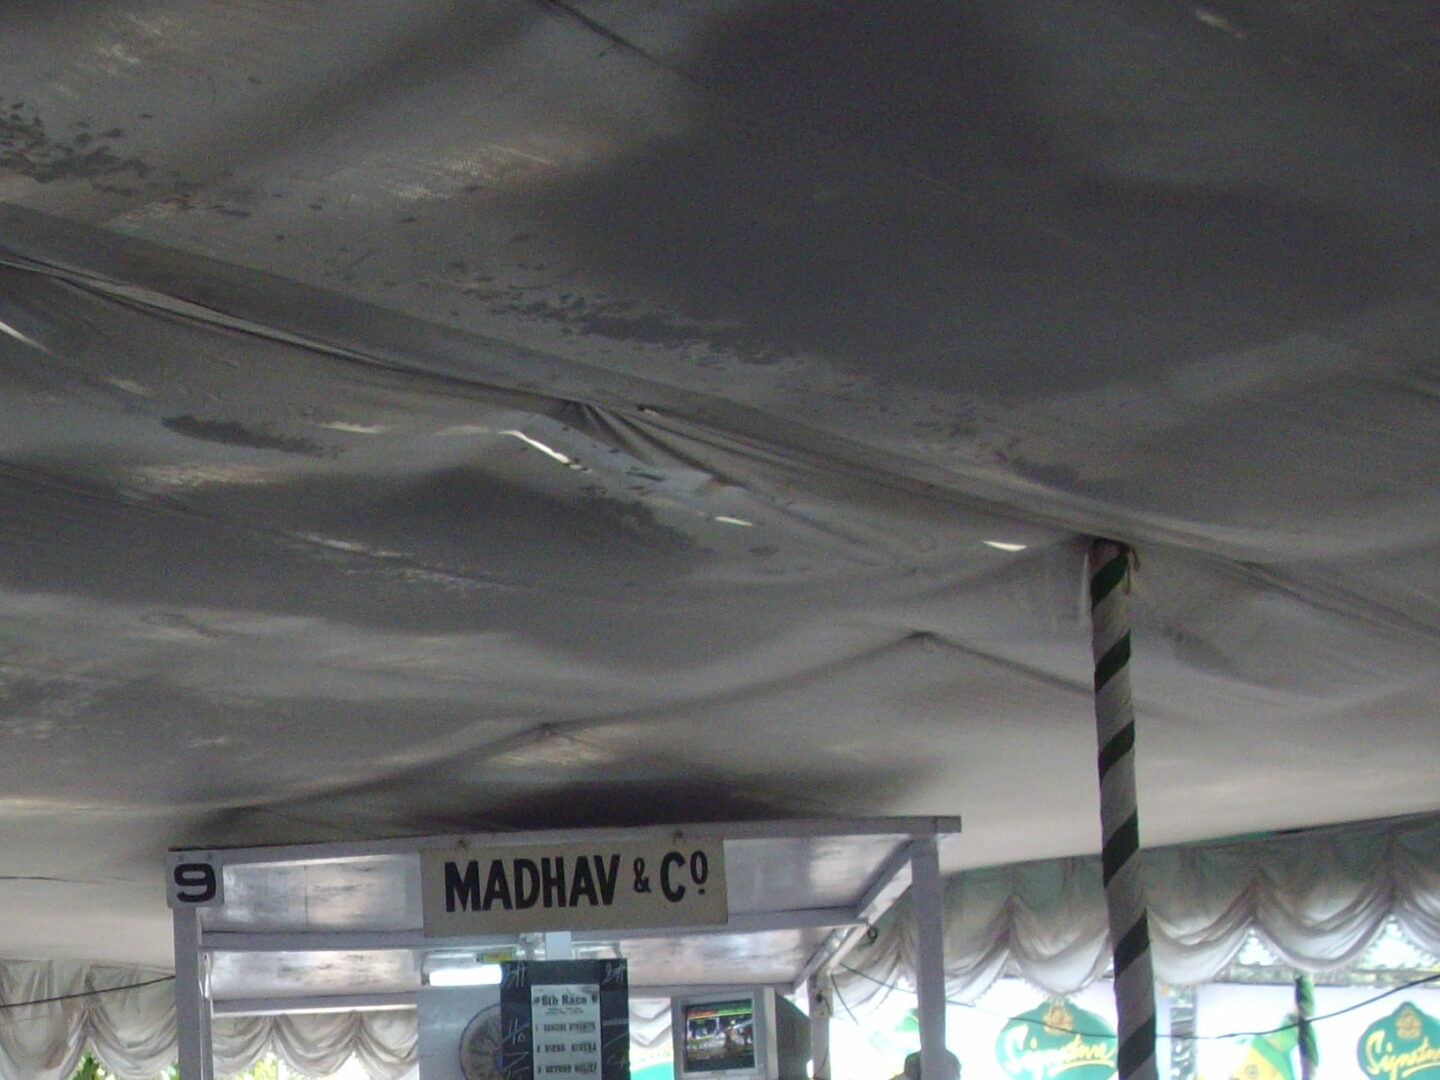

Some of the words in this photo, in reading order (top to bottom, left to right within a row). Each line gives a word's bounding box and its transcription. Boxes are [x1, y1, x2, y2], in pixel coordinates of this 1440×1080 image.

[173, 863, 216, 902] 9
[444, 854, 621, 912] MADHAV
[633, 857, 652, 894] &
